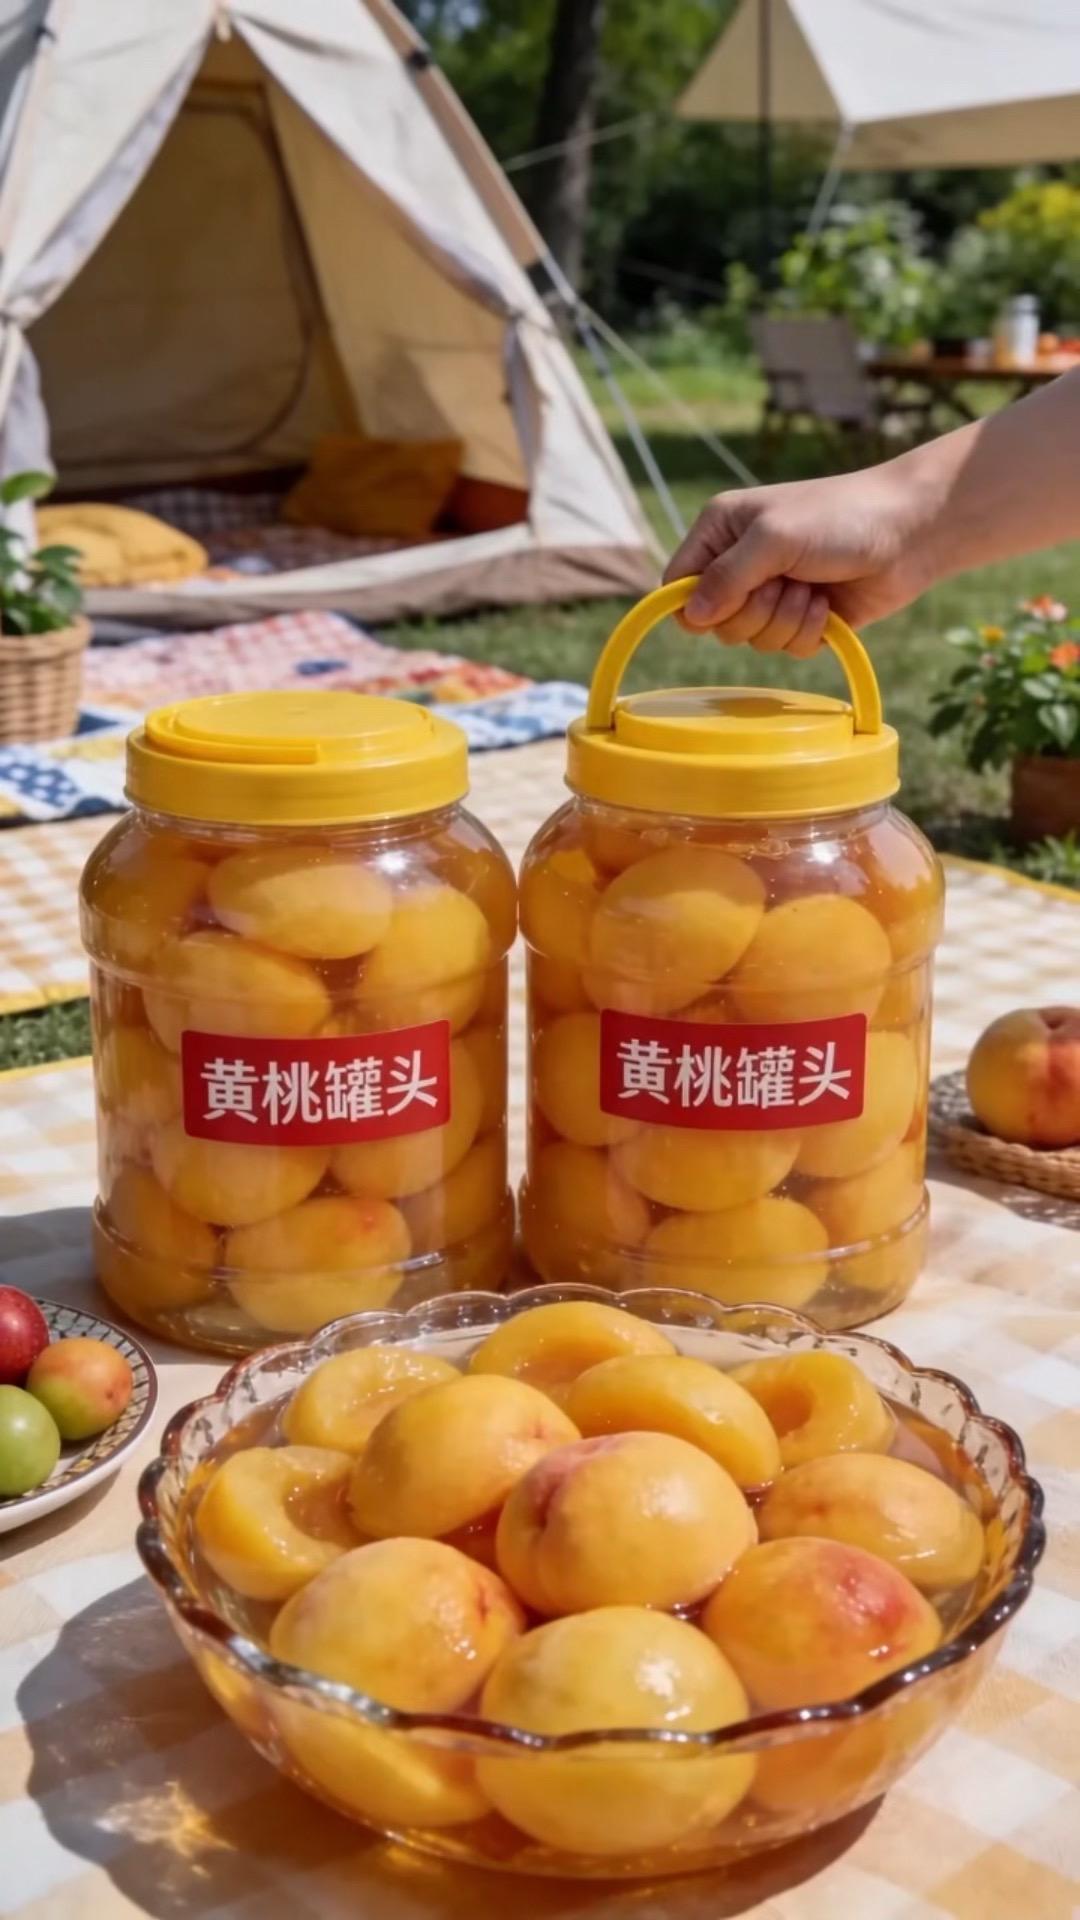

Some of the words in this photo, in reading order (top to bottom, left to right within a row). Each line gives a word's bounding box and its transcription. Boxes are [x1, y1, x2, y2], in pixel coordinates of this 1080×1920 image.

[200, 1050, 438, 1125] 黄桃罐头
[617, 1038, 852, 1109] 黄桃罐头
